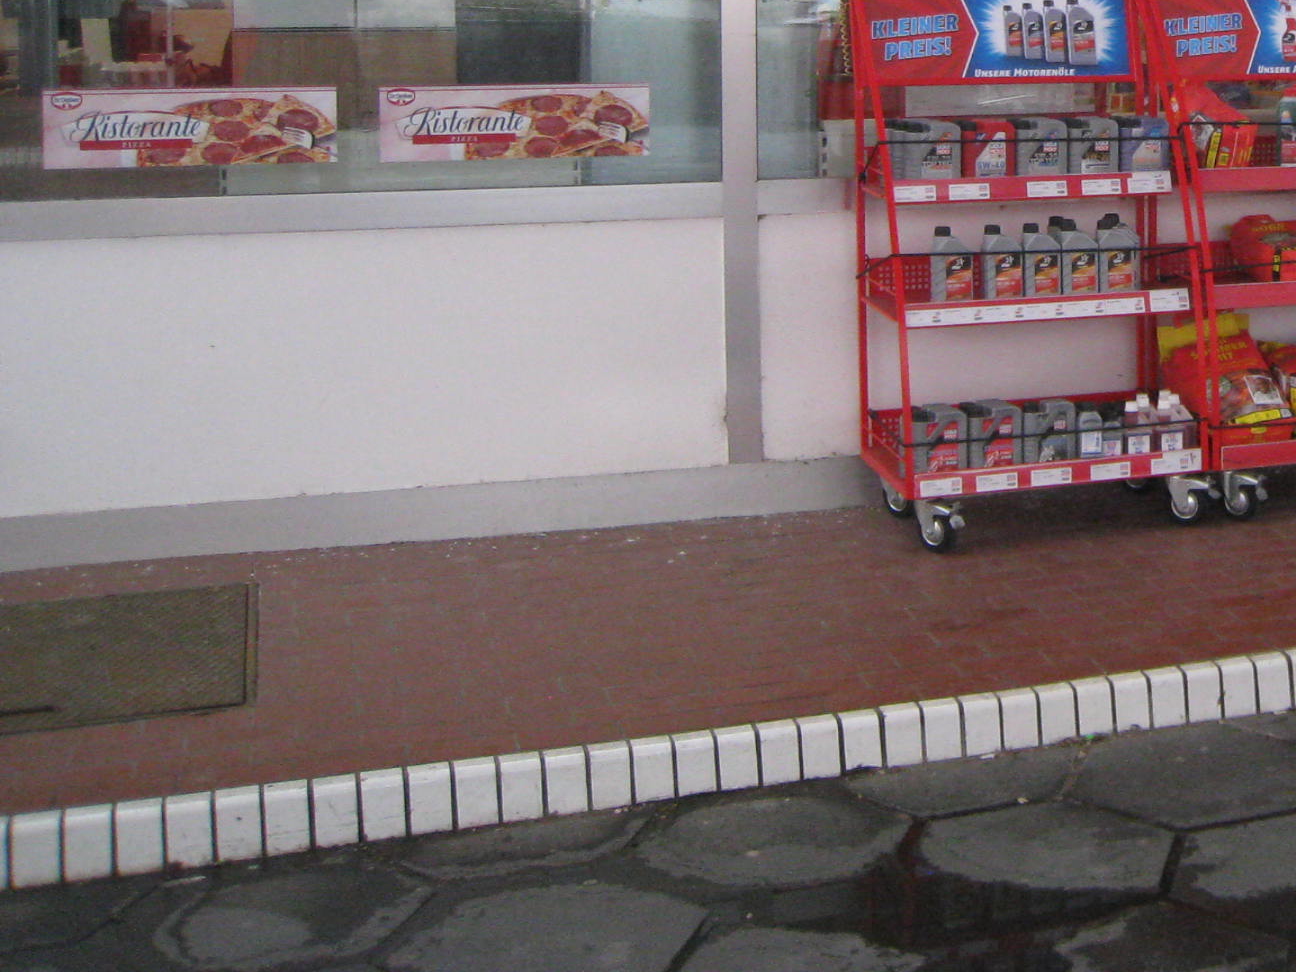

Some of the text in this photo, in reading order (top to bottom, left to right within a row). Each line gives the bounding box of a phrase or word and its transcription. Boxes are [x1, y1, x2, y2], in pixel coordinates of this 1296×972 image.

[871, 13, 959, 40] KLEINER
[1164, 12, 1243, 37] KLEINER
[884, 36, 952, 61] PREIS!
[1176, 34, 1237, 58] PREIS!
[69, 110, 202, 142] Ristorante
[403, 107, 524, 137] Ristorante
